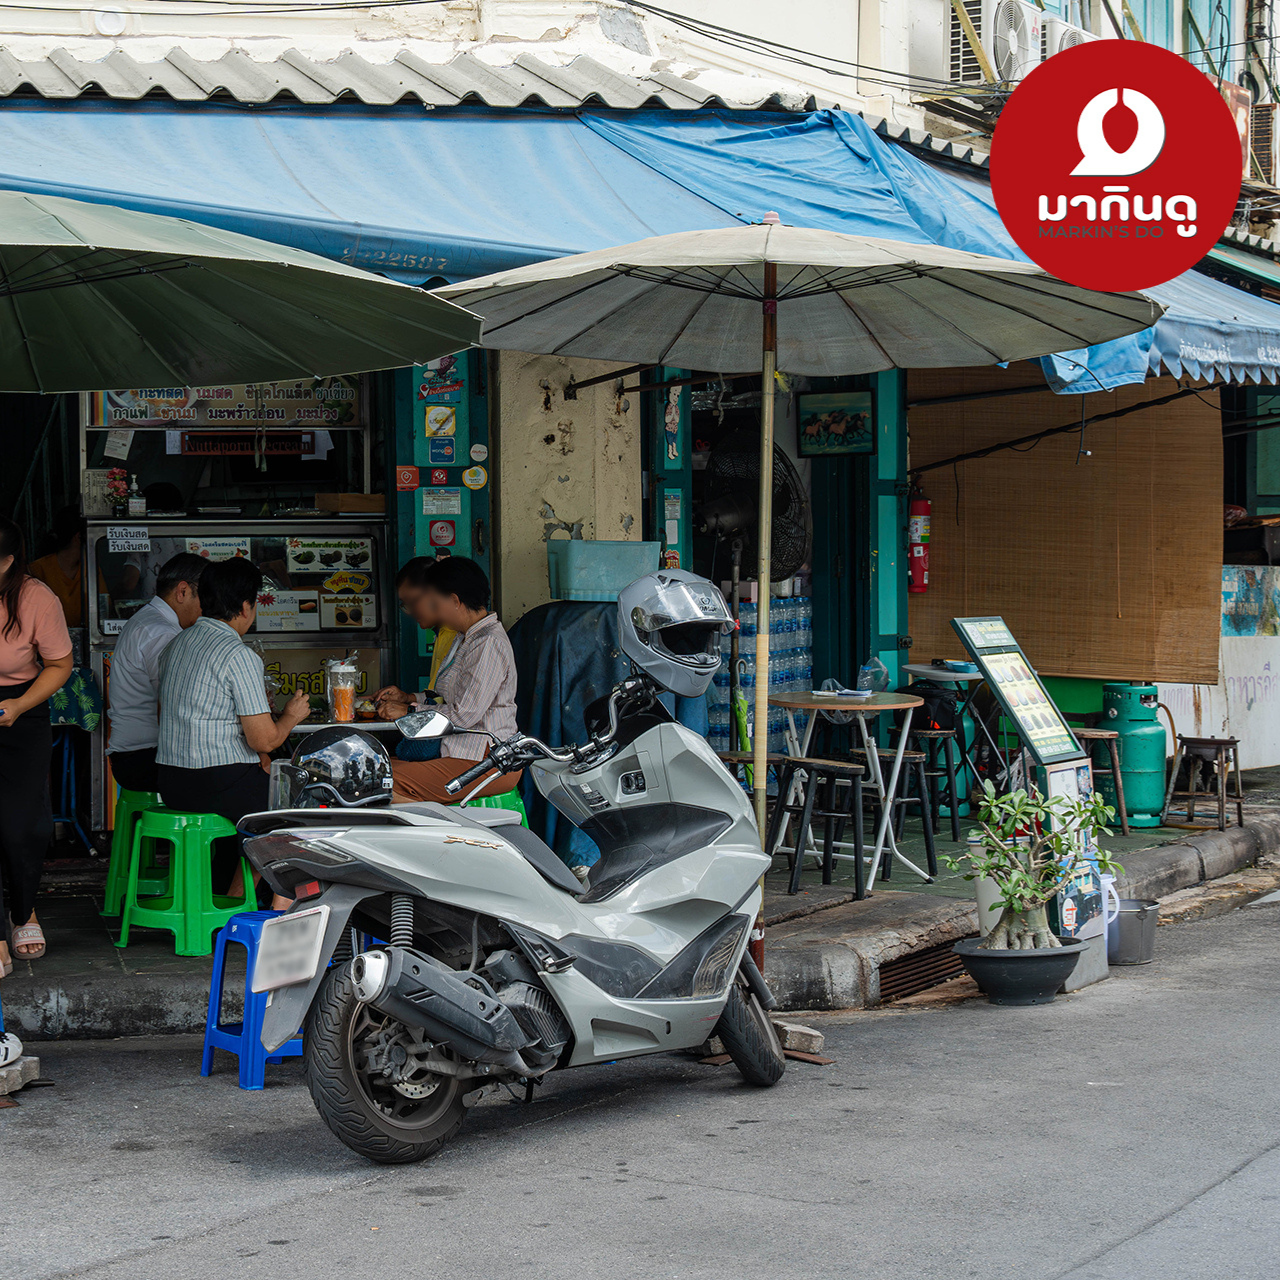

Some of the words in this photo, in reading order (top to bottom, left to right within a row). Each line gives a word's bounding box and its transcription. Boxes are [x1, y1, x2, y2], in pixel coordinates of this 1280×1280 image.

[196, 388, 232, 400] นมสด
[113, 406, 149, 420] กาแฟ
[161, 407, 196, 420] ชานม
[296, 405, 339, 420] มะม่วง
[108, 528, 148, 539] รับเงินสด
[110, 541, 150, 552] รับเงินสด
[271, 861, 289, 870] HONDA
